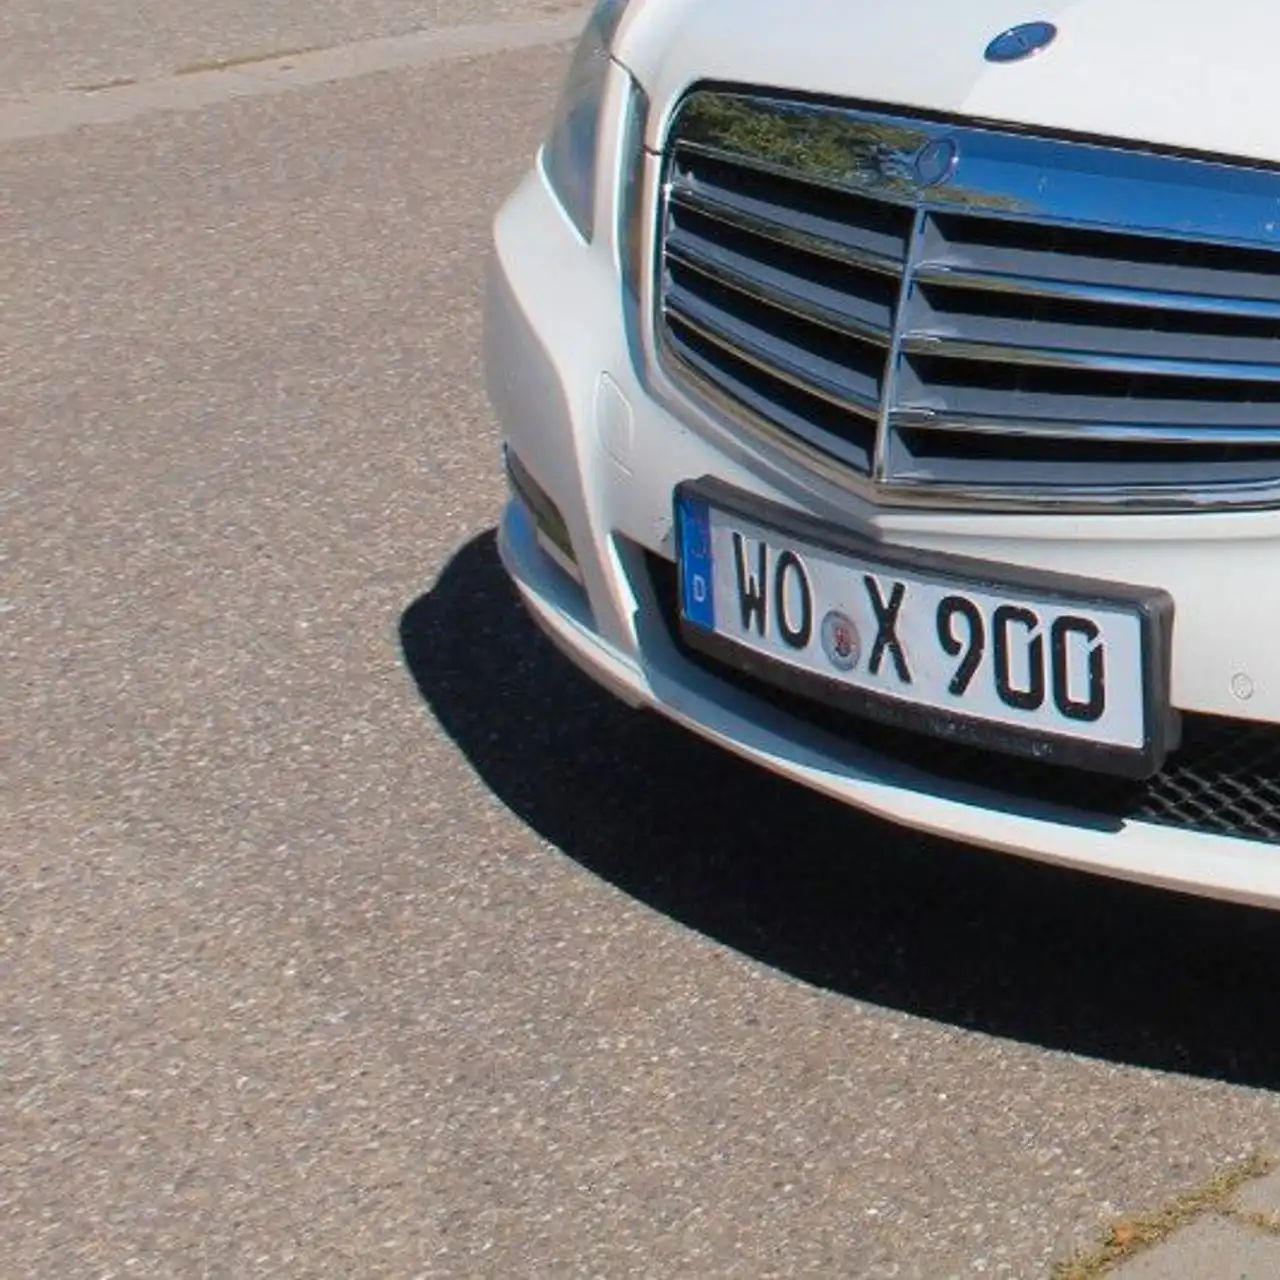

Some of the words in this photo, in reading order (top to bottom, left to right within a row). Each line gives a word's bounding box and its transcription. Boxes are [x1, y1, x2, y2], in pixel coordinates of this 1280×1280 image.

[692, 573, 707, 603] D
[732, 531, 813, 651] WO
[863, 574, 912, 684] X
[936, 595, 1106, 722] 900
